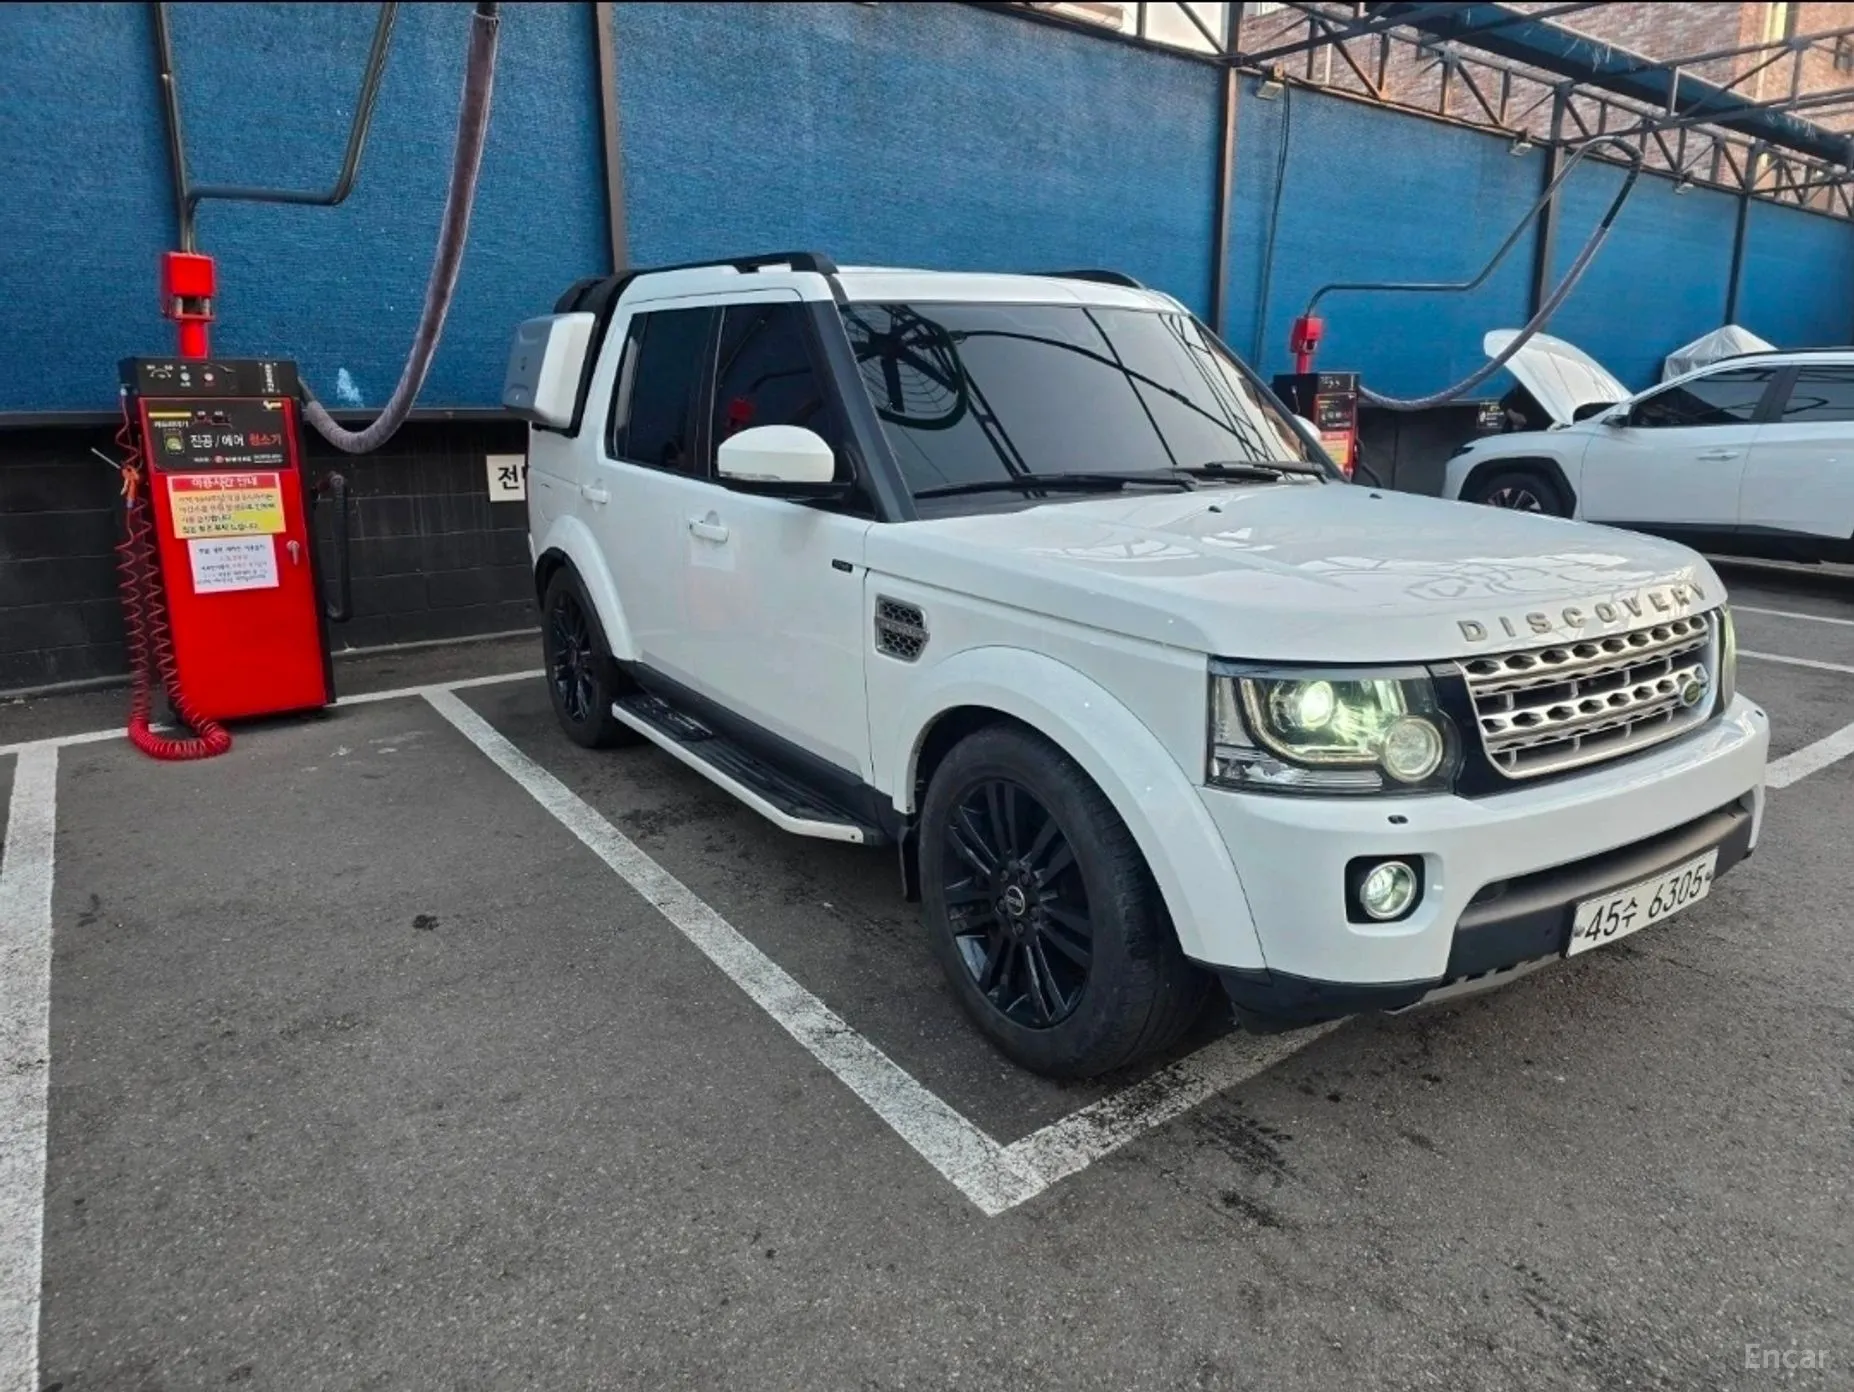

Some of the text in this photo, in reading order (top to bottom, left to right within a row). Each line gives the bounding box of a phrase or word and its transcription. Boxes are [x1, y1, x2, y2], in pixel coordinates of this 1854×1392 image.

[190, 433, 213, 448] 진공
[221, 433, 245, 447] 에어
[250, 432, 282, 446] 청소기
[1457, 582, 1707, 642] DISCOVERY
[1584, 863, 1706, 941] 45수 6305
